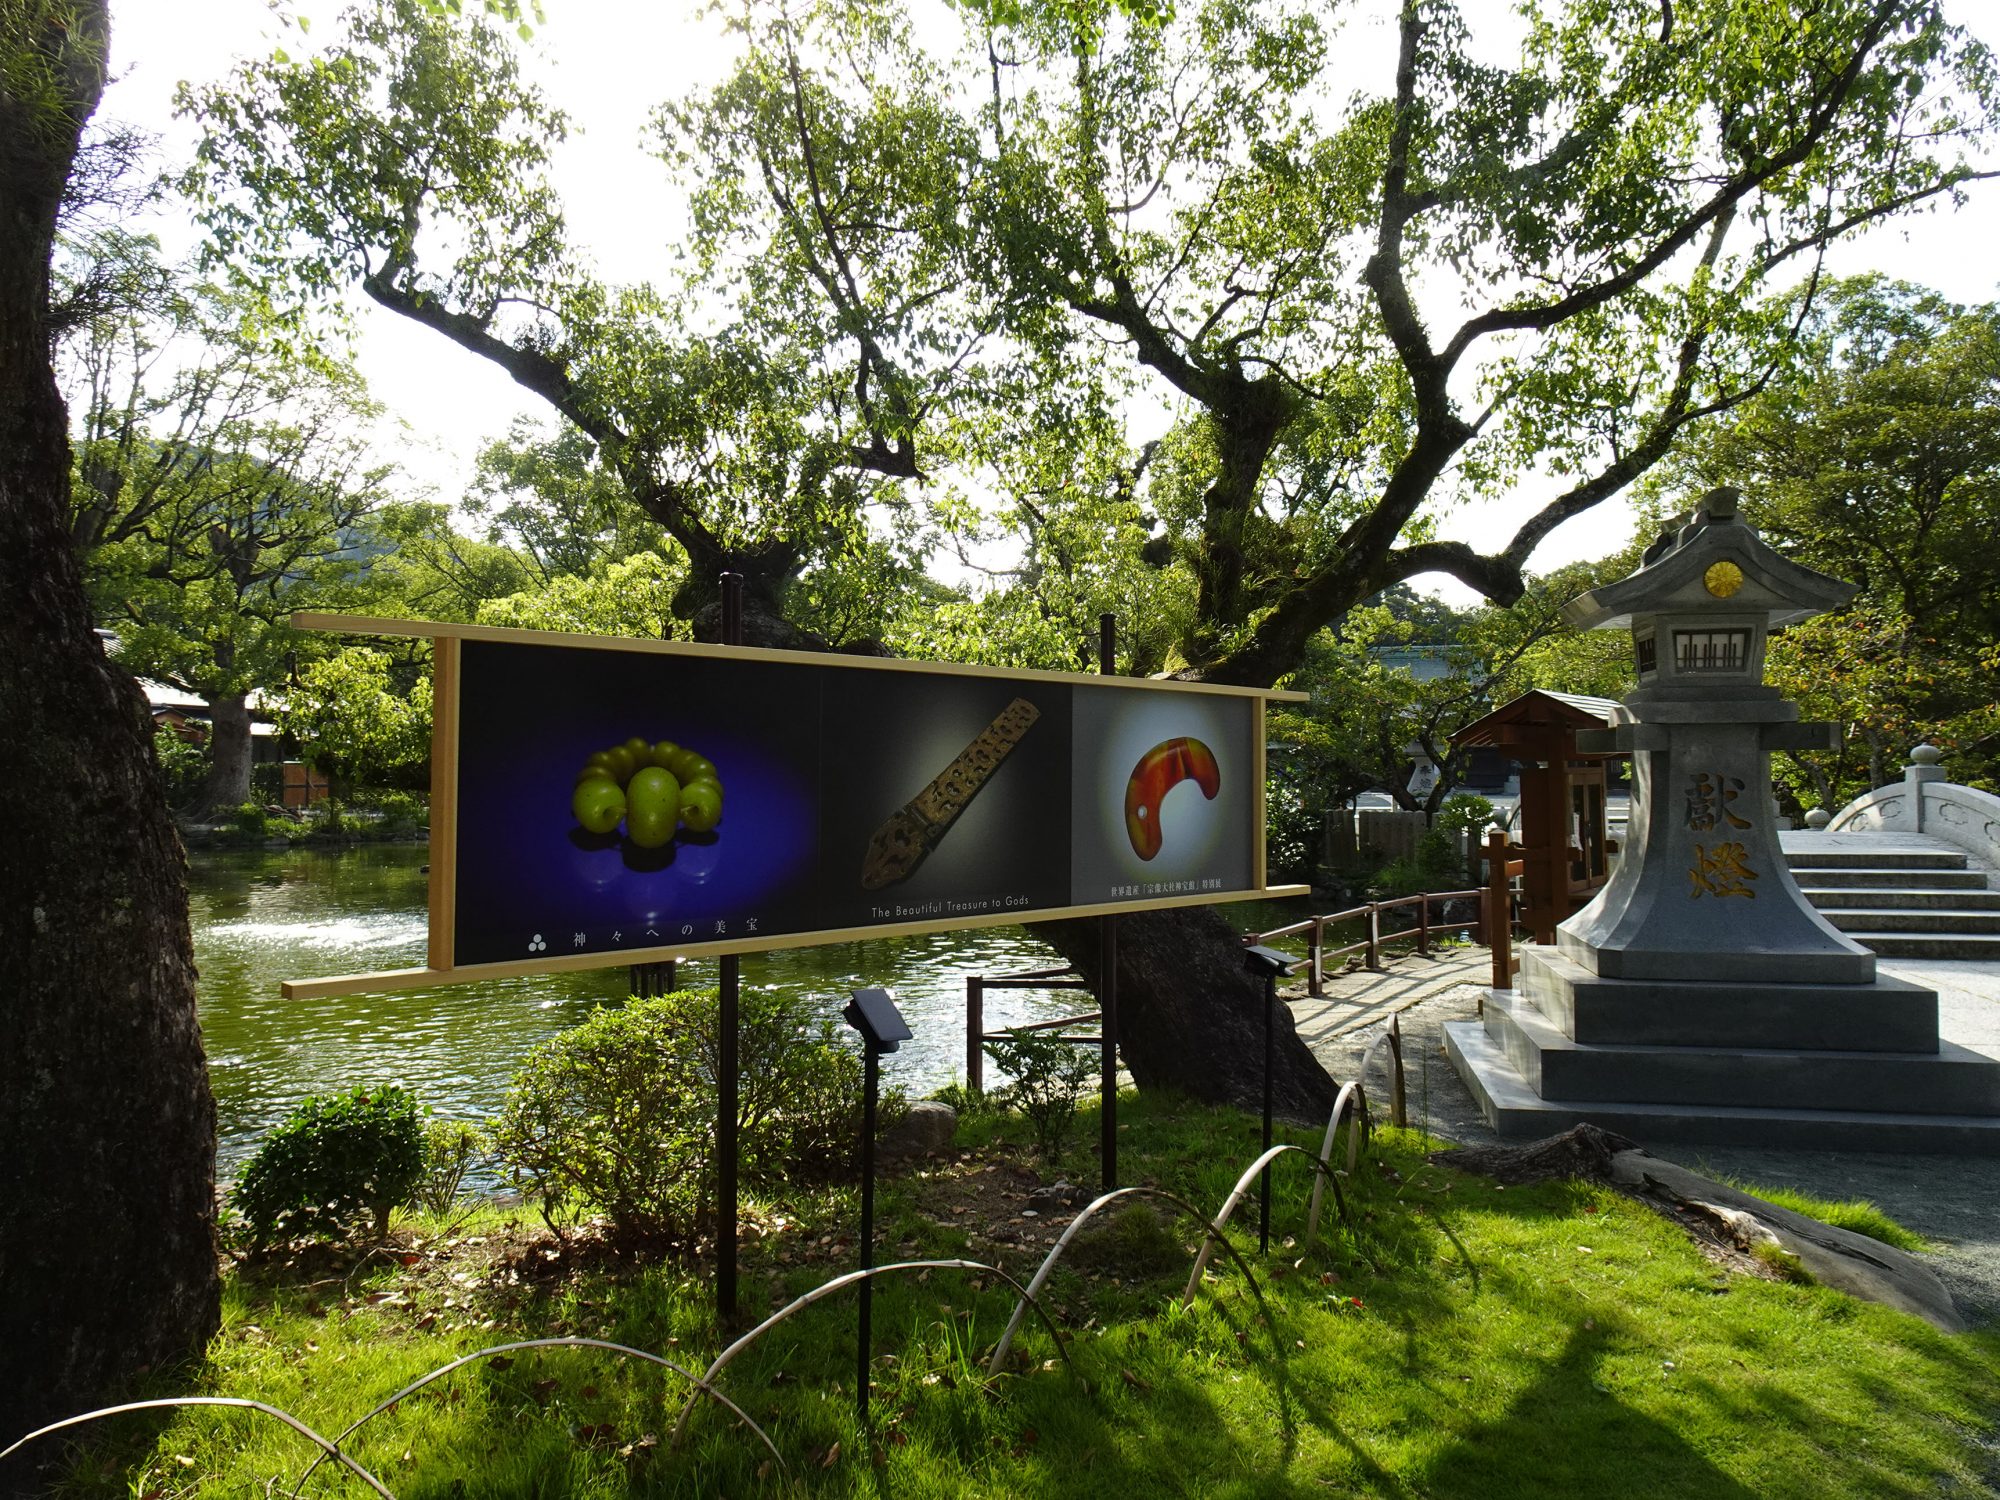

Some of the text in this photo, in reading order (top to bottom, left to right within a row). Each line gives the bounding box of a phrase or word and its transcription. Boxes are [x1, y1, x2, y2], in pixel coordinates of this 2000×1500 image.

[872, 894, 1029, 919] The Beautiful Treasure to Gods
